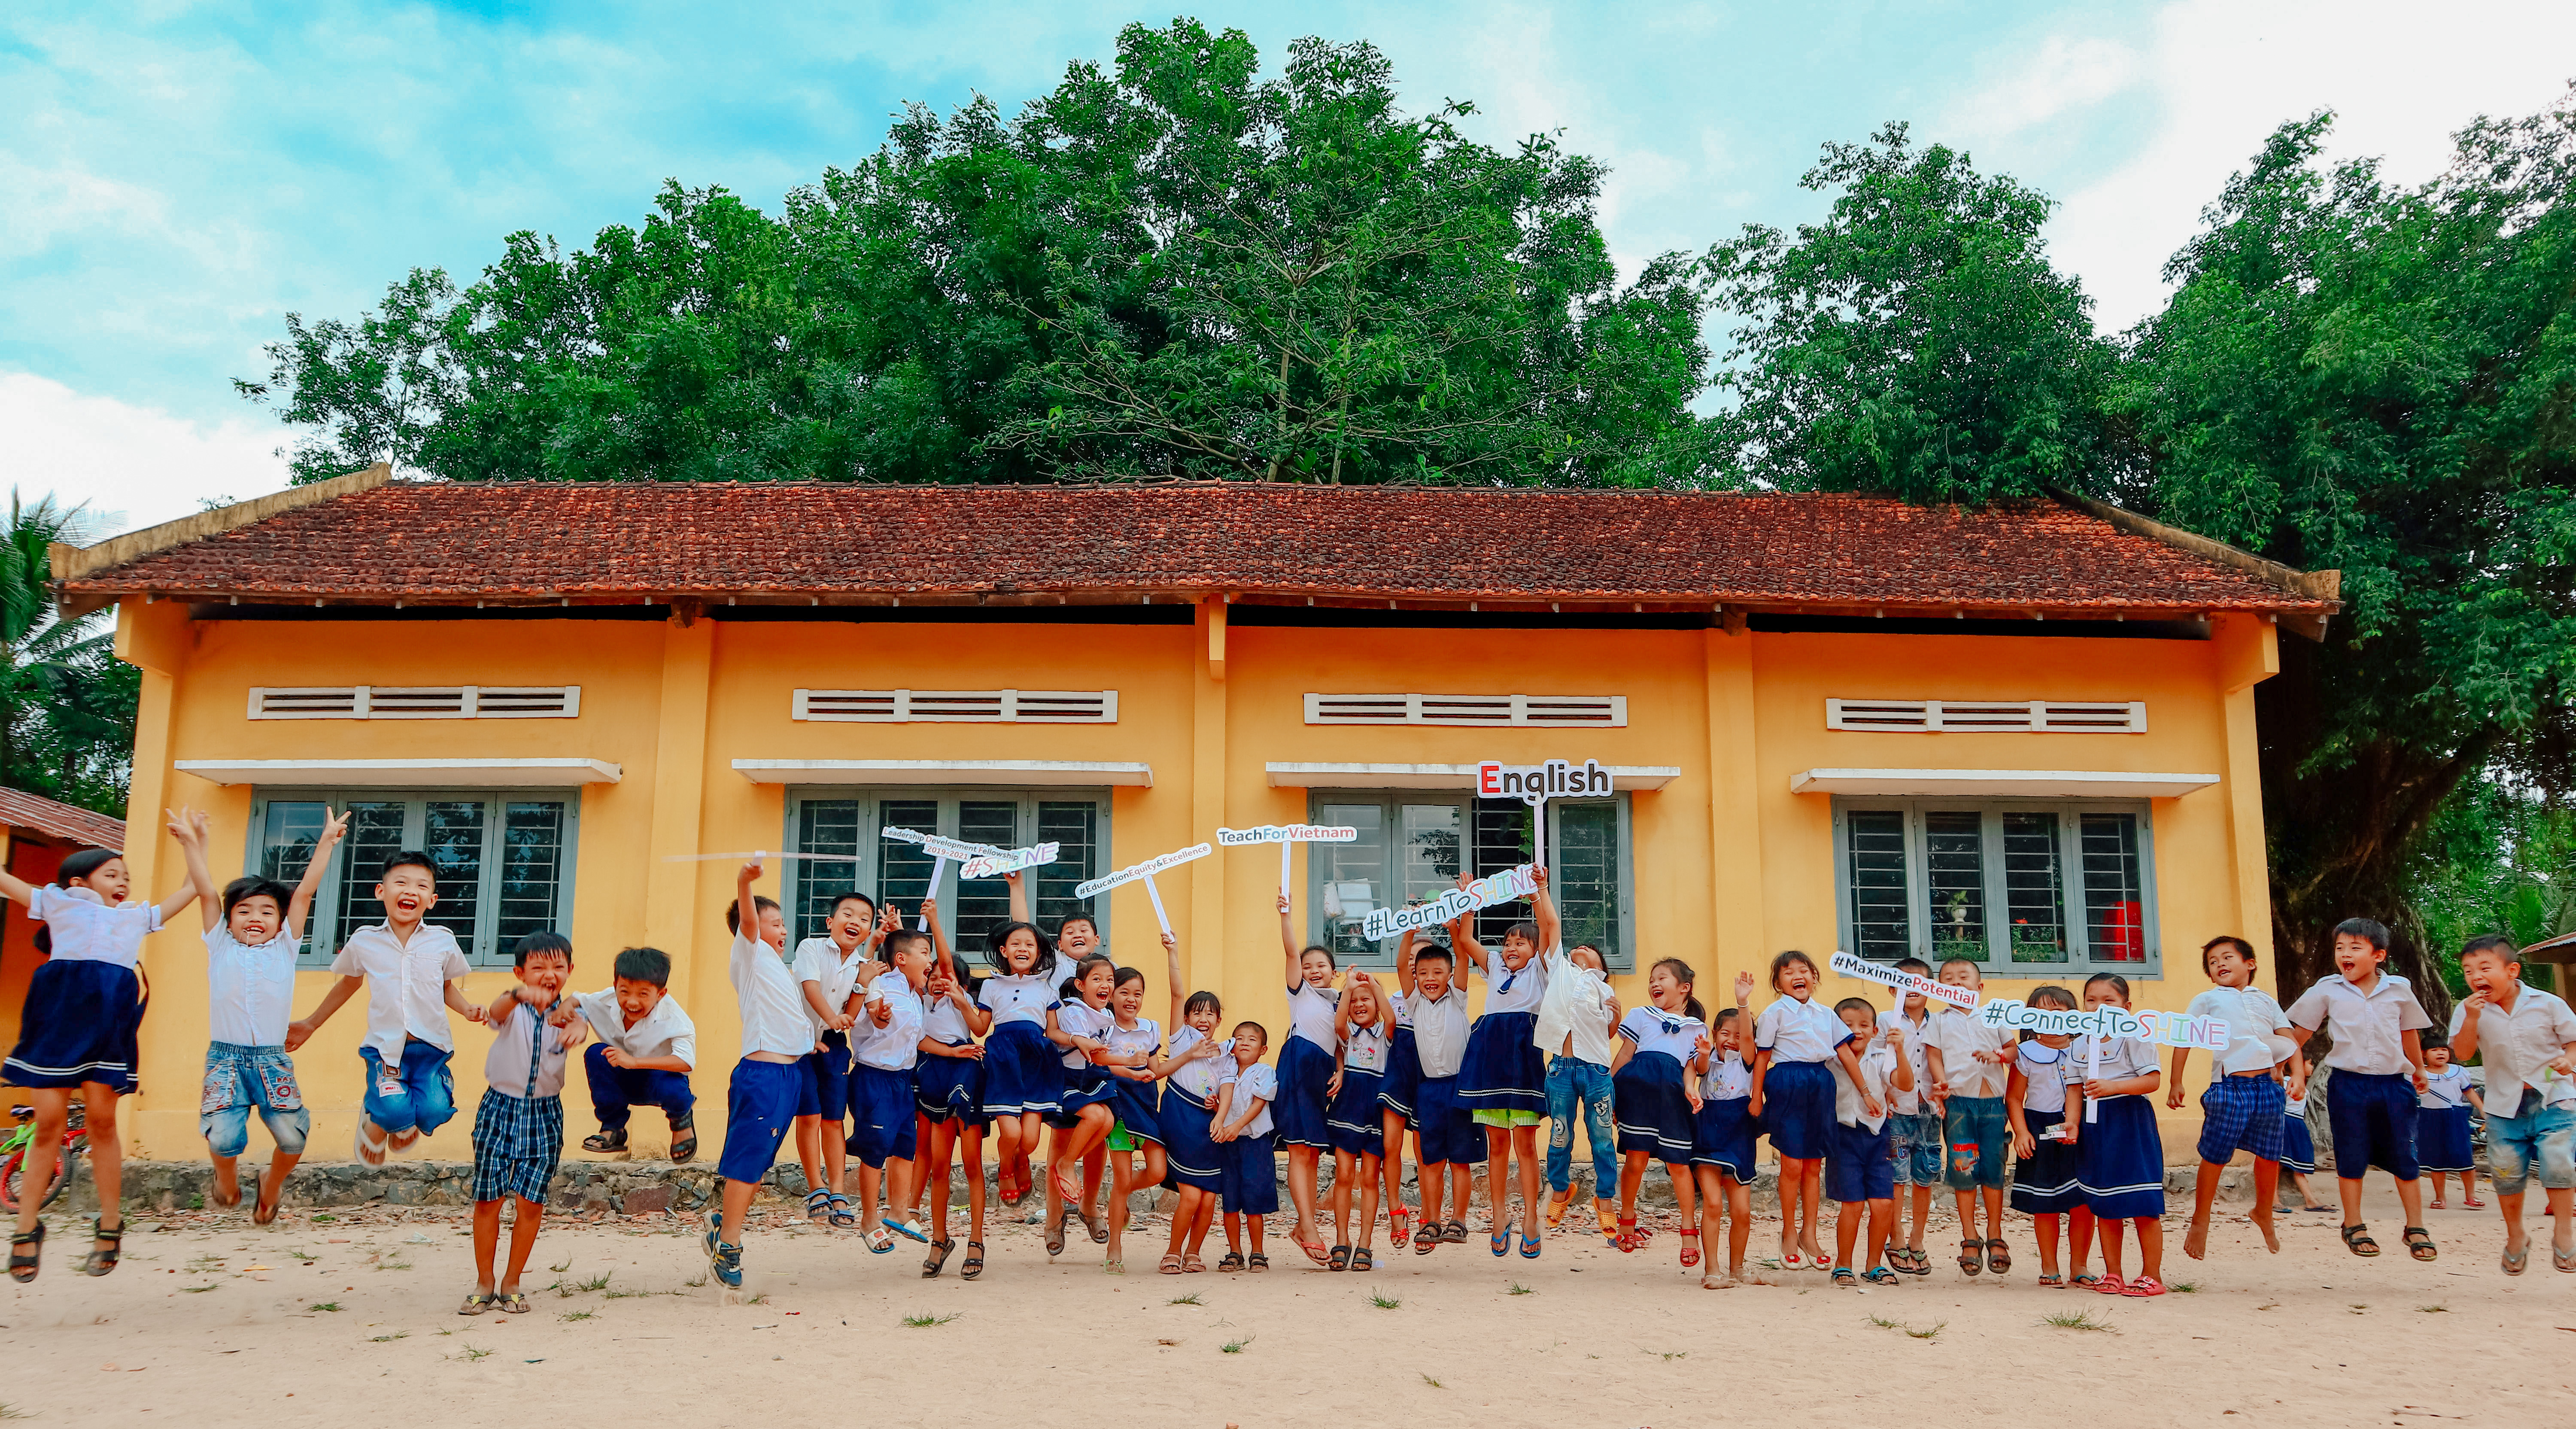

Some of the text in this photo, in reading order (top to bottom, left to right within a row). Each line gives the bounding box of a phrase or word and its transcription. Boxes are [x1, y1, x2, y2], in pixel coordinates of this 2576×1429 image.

[1481, 763, 1608, 801] English
[884, 828, 1019, 861] Leadership Development Fellowship
[927, 845, 968, 860] 2019-2021
[1218, 827, 1354, 843] TeachForVietnam
[963, 844, 1056, 877] #SHINE
[1079, 844, 1209, 895] #EducationEquity&Excellence
[1834, 955, 1976, 1006] #MaximizePotential
[1985, 1002, 2226, 1046] #ConnectToSHINE
